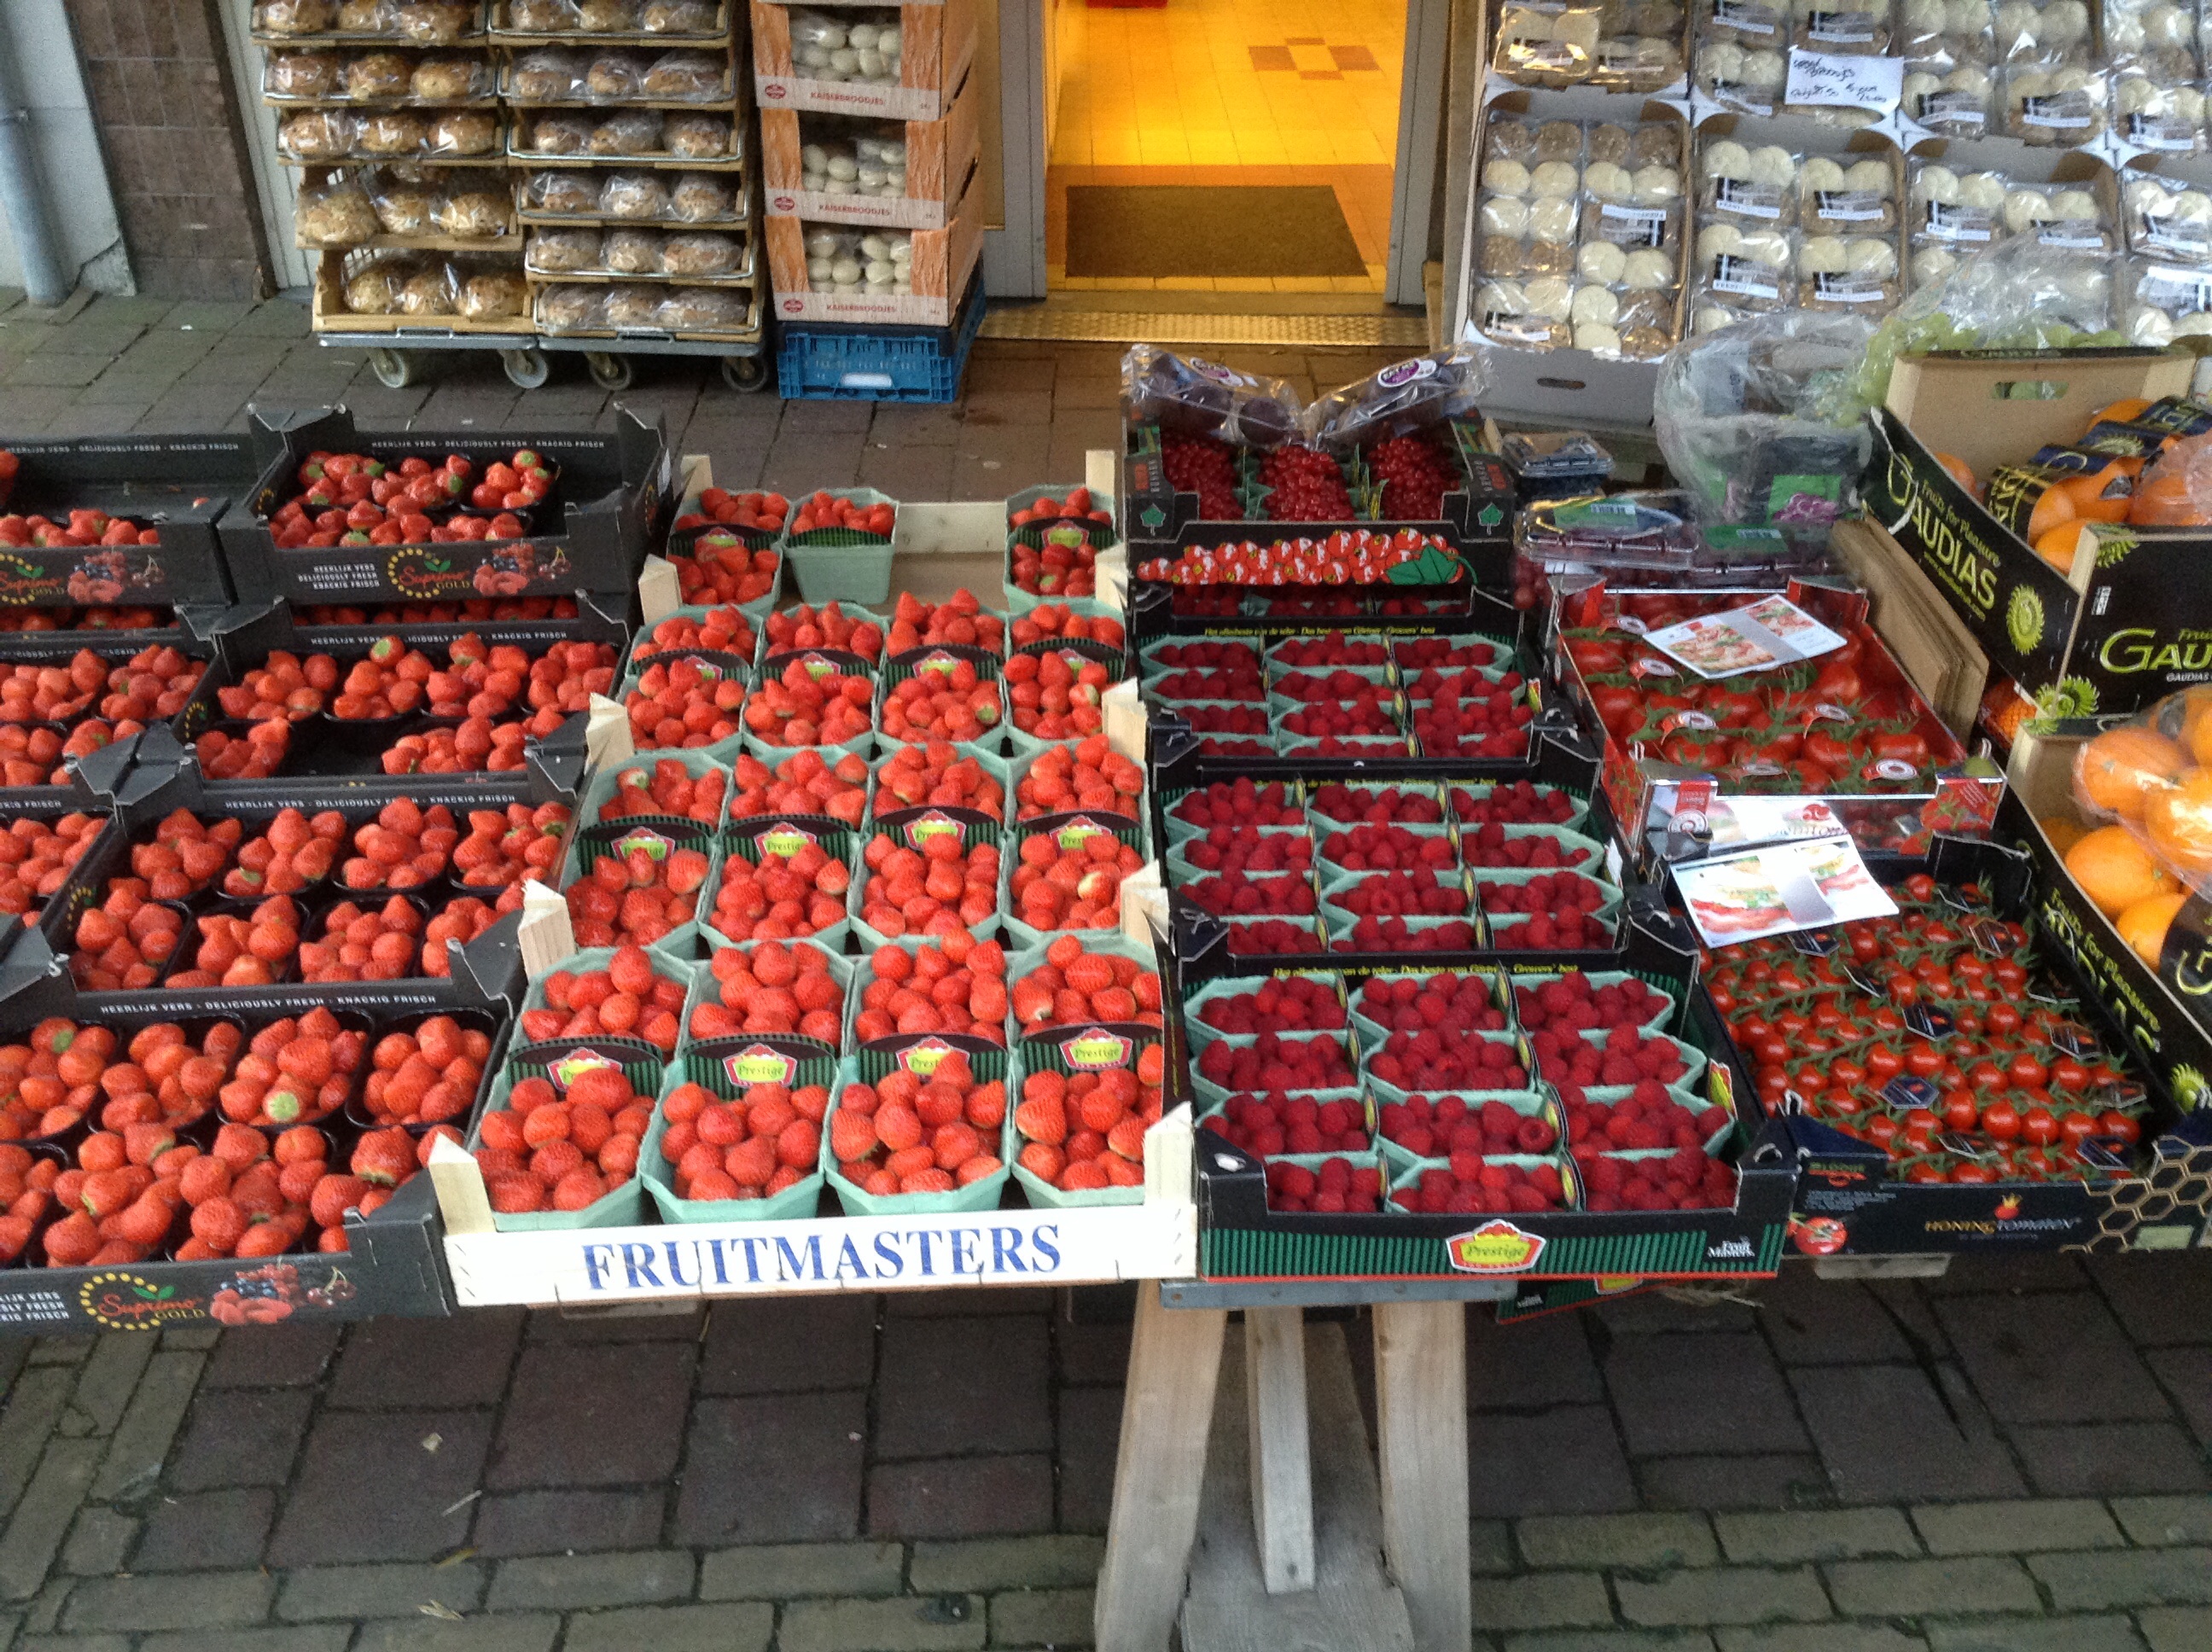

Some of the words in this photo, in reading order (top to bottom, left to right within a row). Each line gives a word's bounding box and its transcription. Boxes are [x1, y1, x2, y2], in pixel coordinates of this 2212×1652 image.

[811, 91, 885, 105] KAISERBROODJES
[819, 204, 890, 215] KAISERBROODJES
[827, 304, 896, 313] KAISERBROODJES
[1888, 452, 1998, 610] GAUDIAS
[2166, 672, 2209, 682] GAUDIAS
[100, 1003, 158, 1014] HEERLIJK
[161, 1002, 193, 1012] VERS
[206, 999, 282, 1010] DELICIOUSLY
[285, 997, 324, 1008] FRESH
[393, 994, 436, 1004] FRISCH
[1074, 1046, 1121, 1060] Prestige
[737, 1063, 783, 1078] Prestige
[581, 1224, 1062, 1290] FRUITMASTERS
[1468, 1244, 1525, 1259] Prestige
[28, 1291, 61, 1300] VERS
[26, 1301, 65, 1312] FRESH
[26, 1311, 69, 1321] FRISCH
[154, 1308, 205, 1321] GOLD
